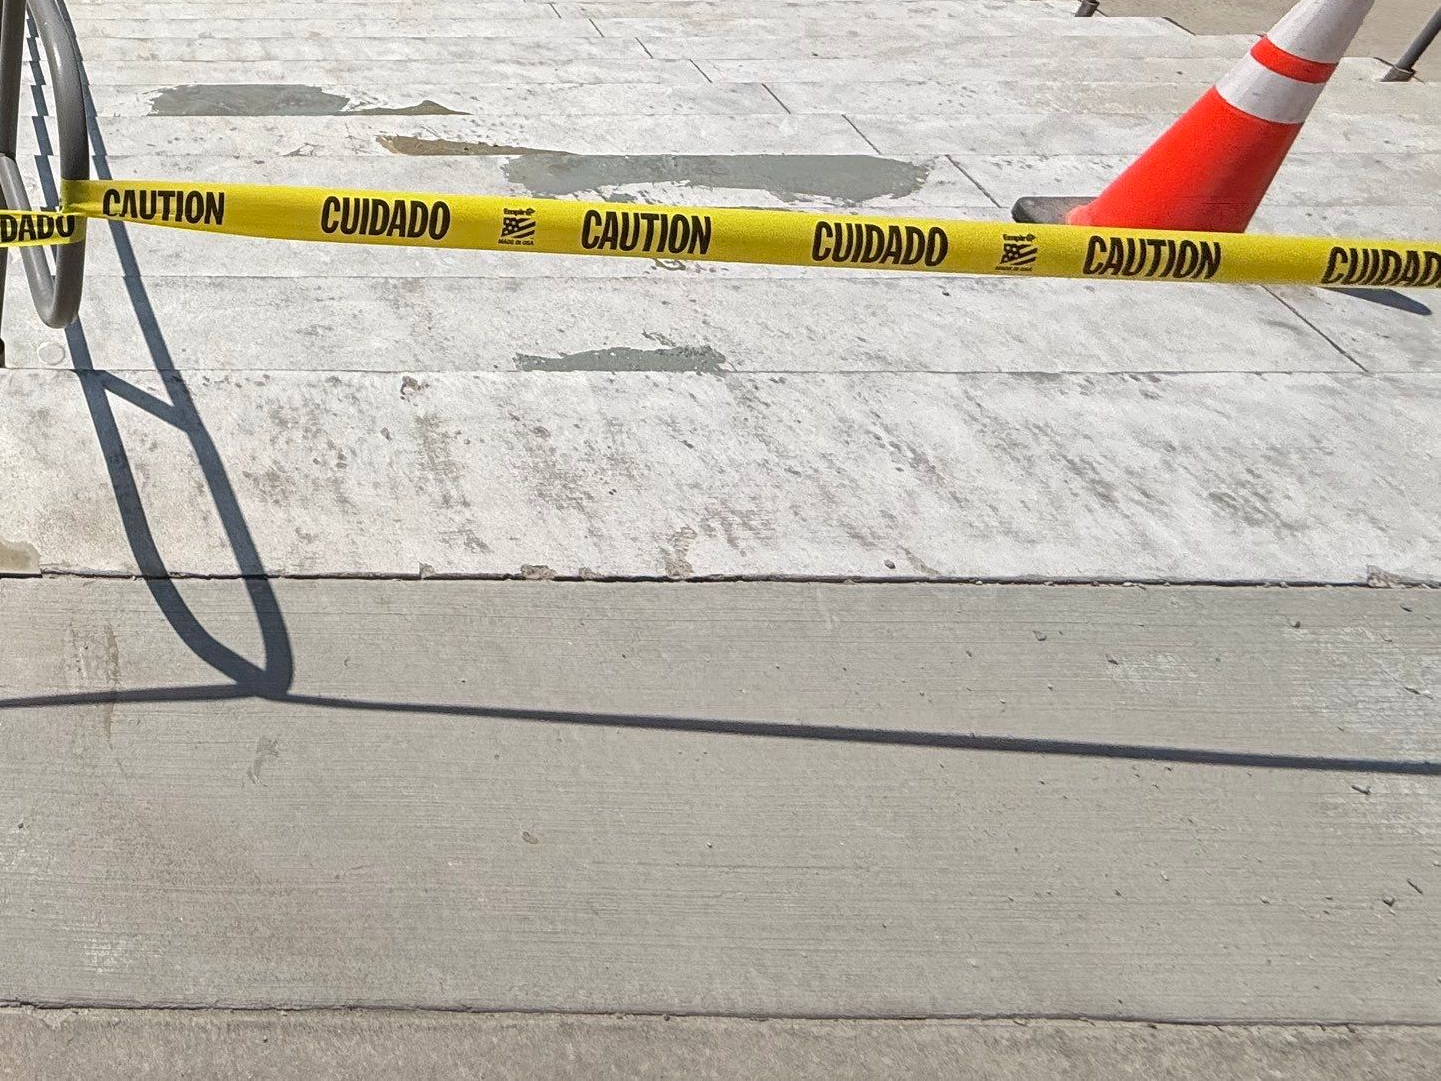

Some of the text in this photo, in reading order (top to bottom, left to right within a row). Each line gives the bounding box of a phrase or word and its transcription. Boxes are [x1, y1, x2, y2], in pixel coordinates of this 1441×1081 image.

[102, 189, 1441, 288] CAUTION CUIDADO CAUTION CUIDADO CAUTION CUIDAD
